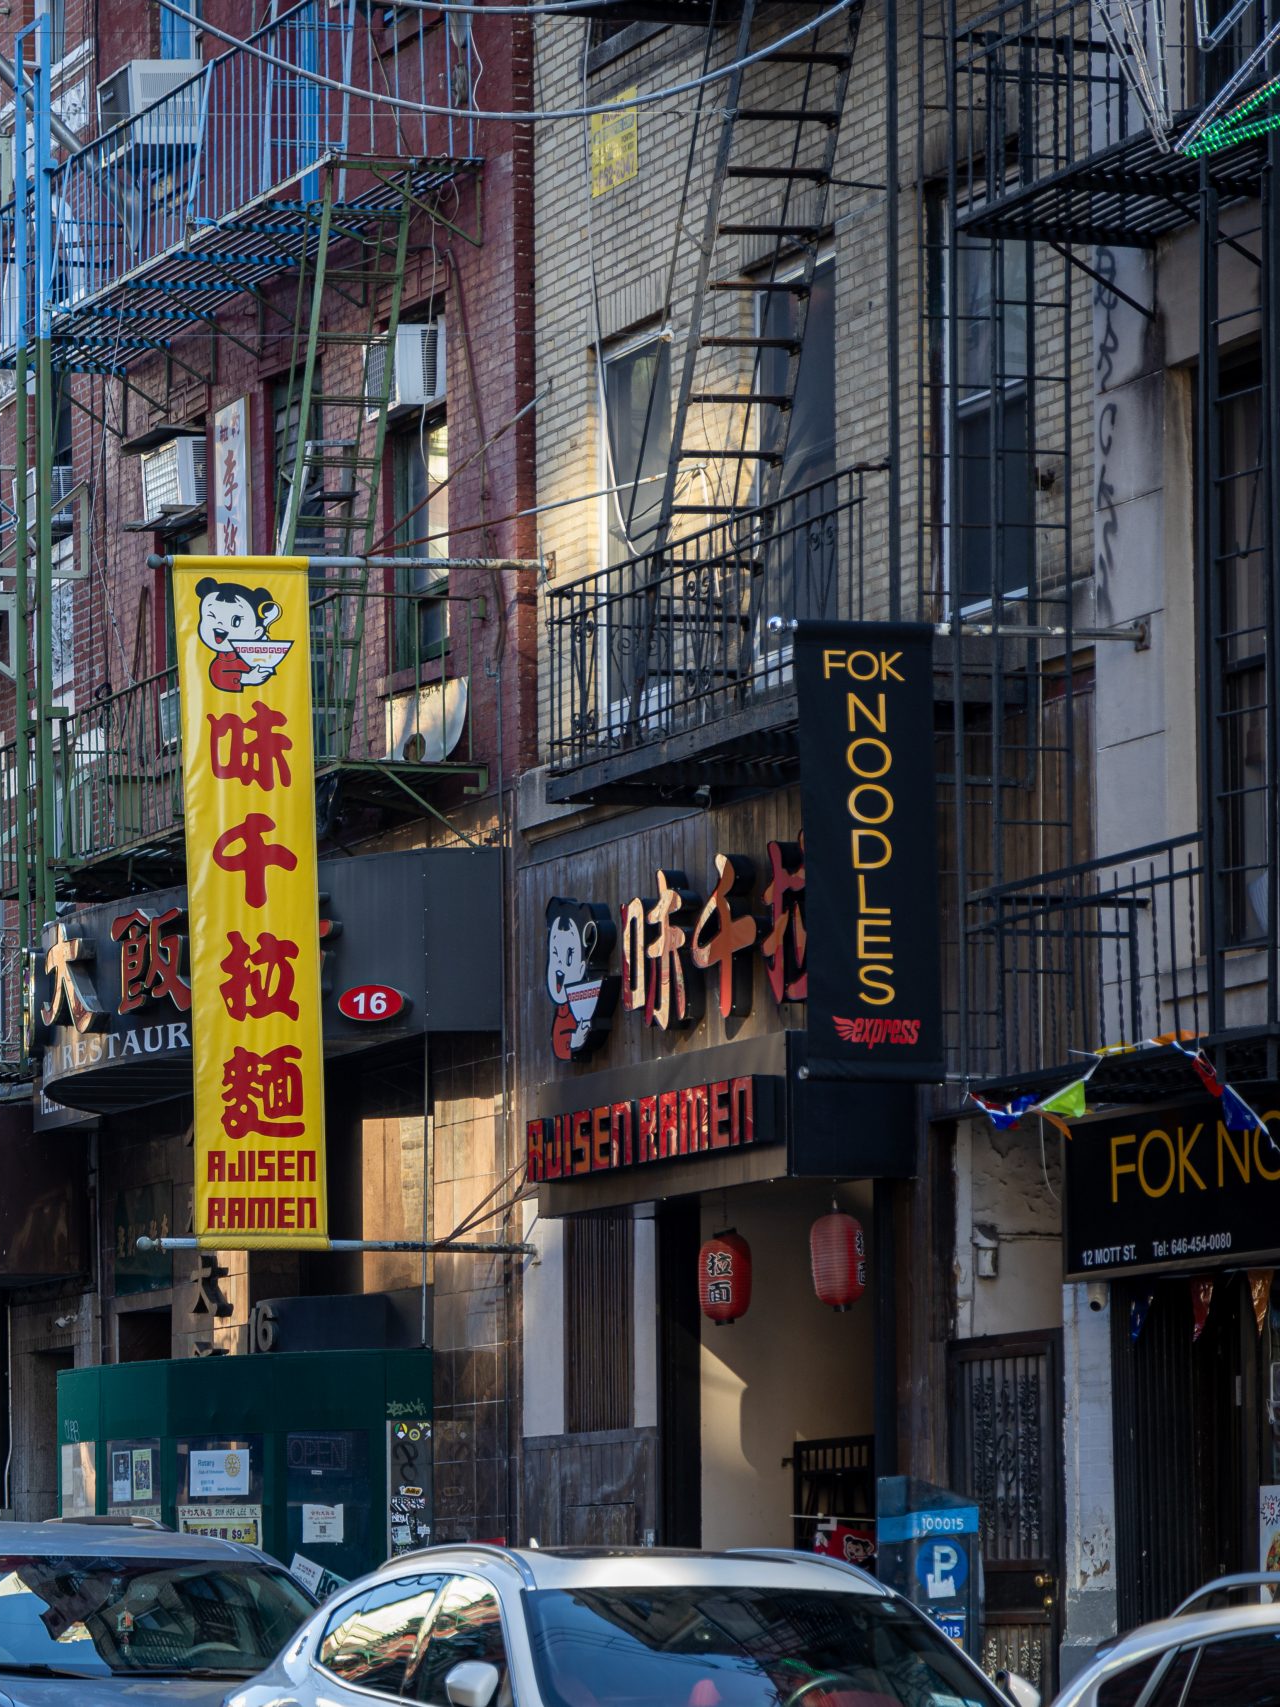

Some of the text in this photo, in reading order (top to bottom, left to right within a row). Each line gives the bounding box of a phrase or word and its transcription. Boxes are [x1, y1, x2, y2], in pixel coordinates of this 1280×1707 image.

[823, 649, 905, 682] FOK
[845, 692, 896, 1006] NOODLES
[206, 700, 306, 1140] 味千拉麵
[353, 992, 387, 1015] 16
[62, 1022, 192, 1070] RESTAUR
[852, 1016, 921, 1050] express
[526, 1074, 755, 1183] AJISEN RAMEN
[207, 1150, 316, 1183] AJISEN
[1111, 1110, 1280, 1203] FOK NO
[207, 1197, 317, 1229] RAMEN
[1082, 1232, 1232, 1266] 12 MOTT ST. Tel: 646-454-0080
[706, 1251, 734, 1304] 拉面
[249, 1303, 278, 1353] 16
[290, 1439, 344, 1467] OPEN
[922, 1517, 964, 1531] 100015
